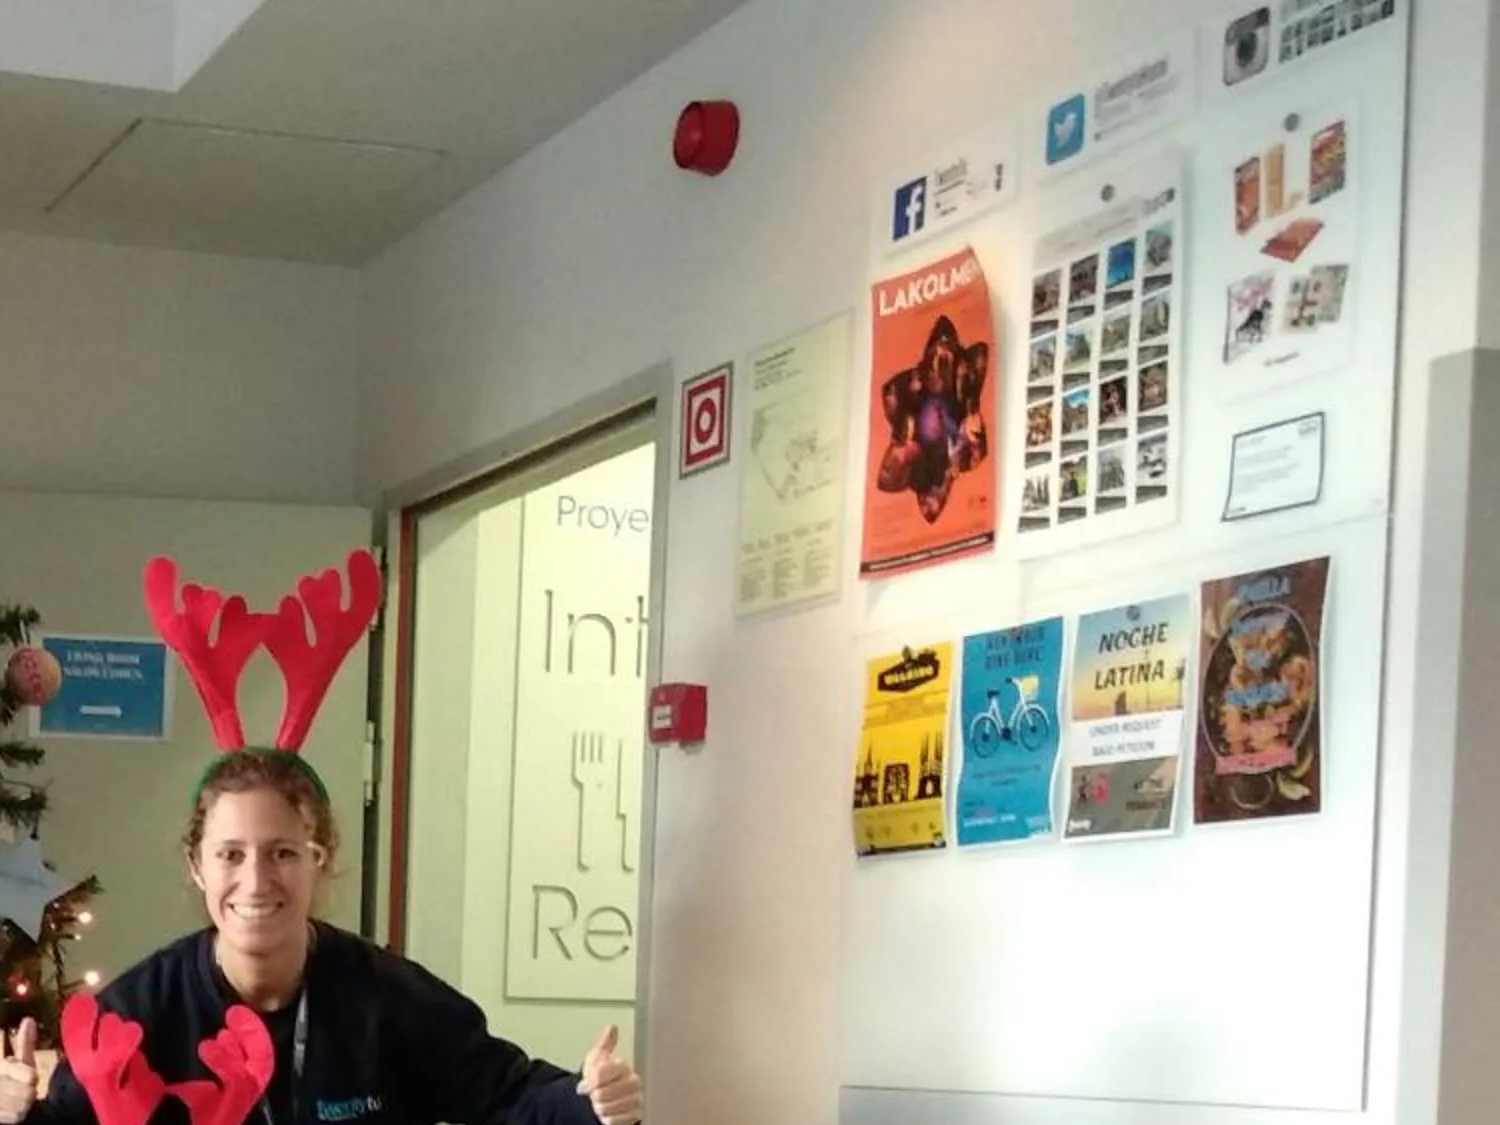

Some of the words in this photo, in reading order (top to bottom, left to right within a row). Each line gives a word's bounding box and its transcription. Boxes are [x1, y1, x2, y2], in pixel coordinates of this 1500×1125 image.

[557, 495, 650, 537] Proye
[1099, 622, 1169, 654] NOCHE
[1094, 660, 1165, 691] LATINA
[531, 884, 633, 963] Re
